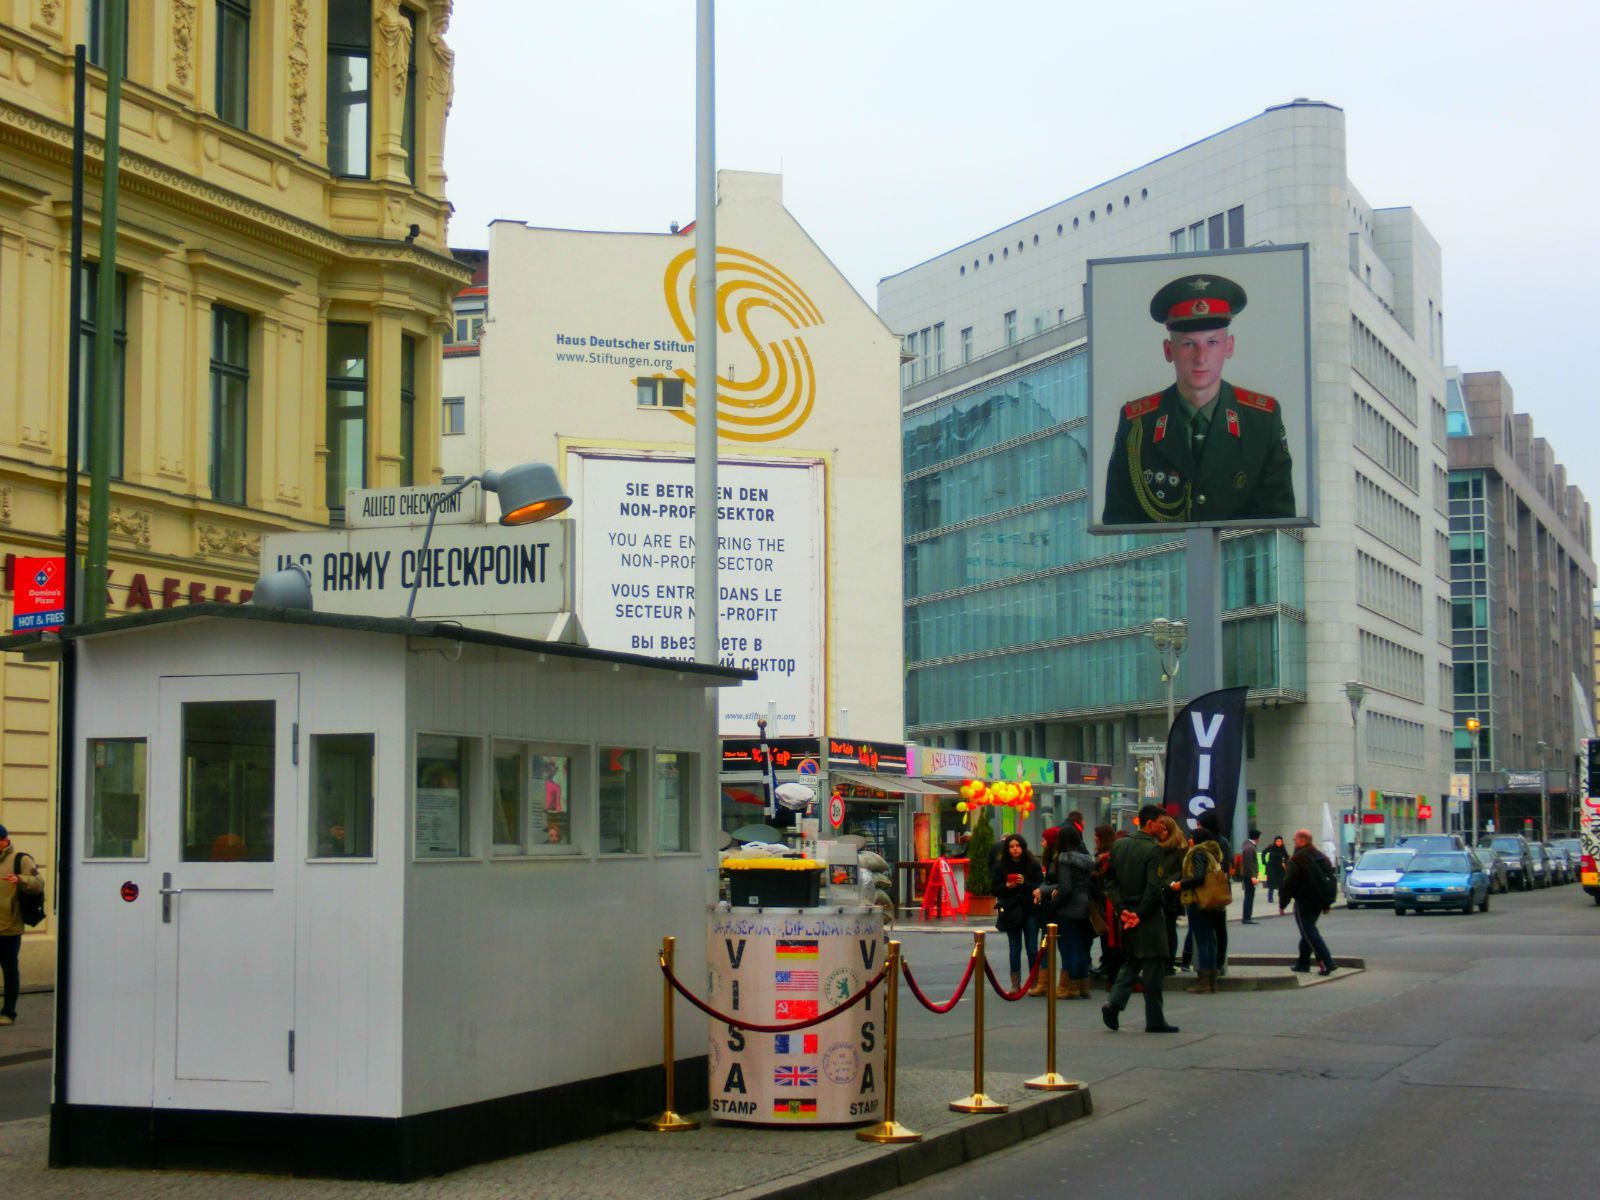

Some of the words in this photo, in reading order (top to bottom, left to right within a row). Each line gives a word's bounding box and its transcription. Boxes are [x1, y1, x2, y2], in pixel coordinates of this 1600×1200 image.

[556, 333, 586, 346] Haus
[590, 336, 650, 351] Deutscher
[653, 340, 695, 353] Stiftun
[556, 351, 673, 370] www.Stiftungen.org
[626, 483, 649, 497] SIE
[656, 484, 733, 500] BETREN
[739, 487, 769, 502] DEN
[363, 495, 396, 517] ALLIED
[400, 491, 463, 516] CHECKPOINT
[608, 532, 637, 547] YOU
[643, 534, 672, 548] ARE
[679, 535, 752, 551] ENRING
[758, 538, 785, 552] THE
[323, 550, 391, 591] ARMY
[401, 543, 550, 589] CHECKPOINT
[621, 554, 696, 569] NON-PROF
[718, 557, 773, 572] SECTOR
[28, 589, 61, 597] Domino's
[611, 584, 650, 598] VOUS
[657, 585, 695, 599] ENTR
[720, 587, 758, 601] DANS
[765, 588, 782, 602] LE
[18, 615, 35, 627] HOT
[36, 616, 43, 625] &
[45, 612, 65, 623] FRES
[616, 604, 682, 619] SECTEUR
[688, 606, 778, 622] N-PROFIT
[742, 657, 796, 676] сектор
[724, 711, 796, 721] www.stiftunn.org
[930, 752, 948, 774] ASIA
[948, 753, 978, 776] EXPRESS
[1186, 711, 1225, 831] VIS
[723, 939, 747, 1094] VISA
[859, 939, 876, 1094] VISA
[712, 1098, 758, 1115] STAMP
[849, 1099, 879, 1116] STAMP
